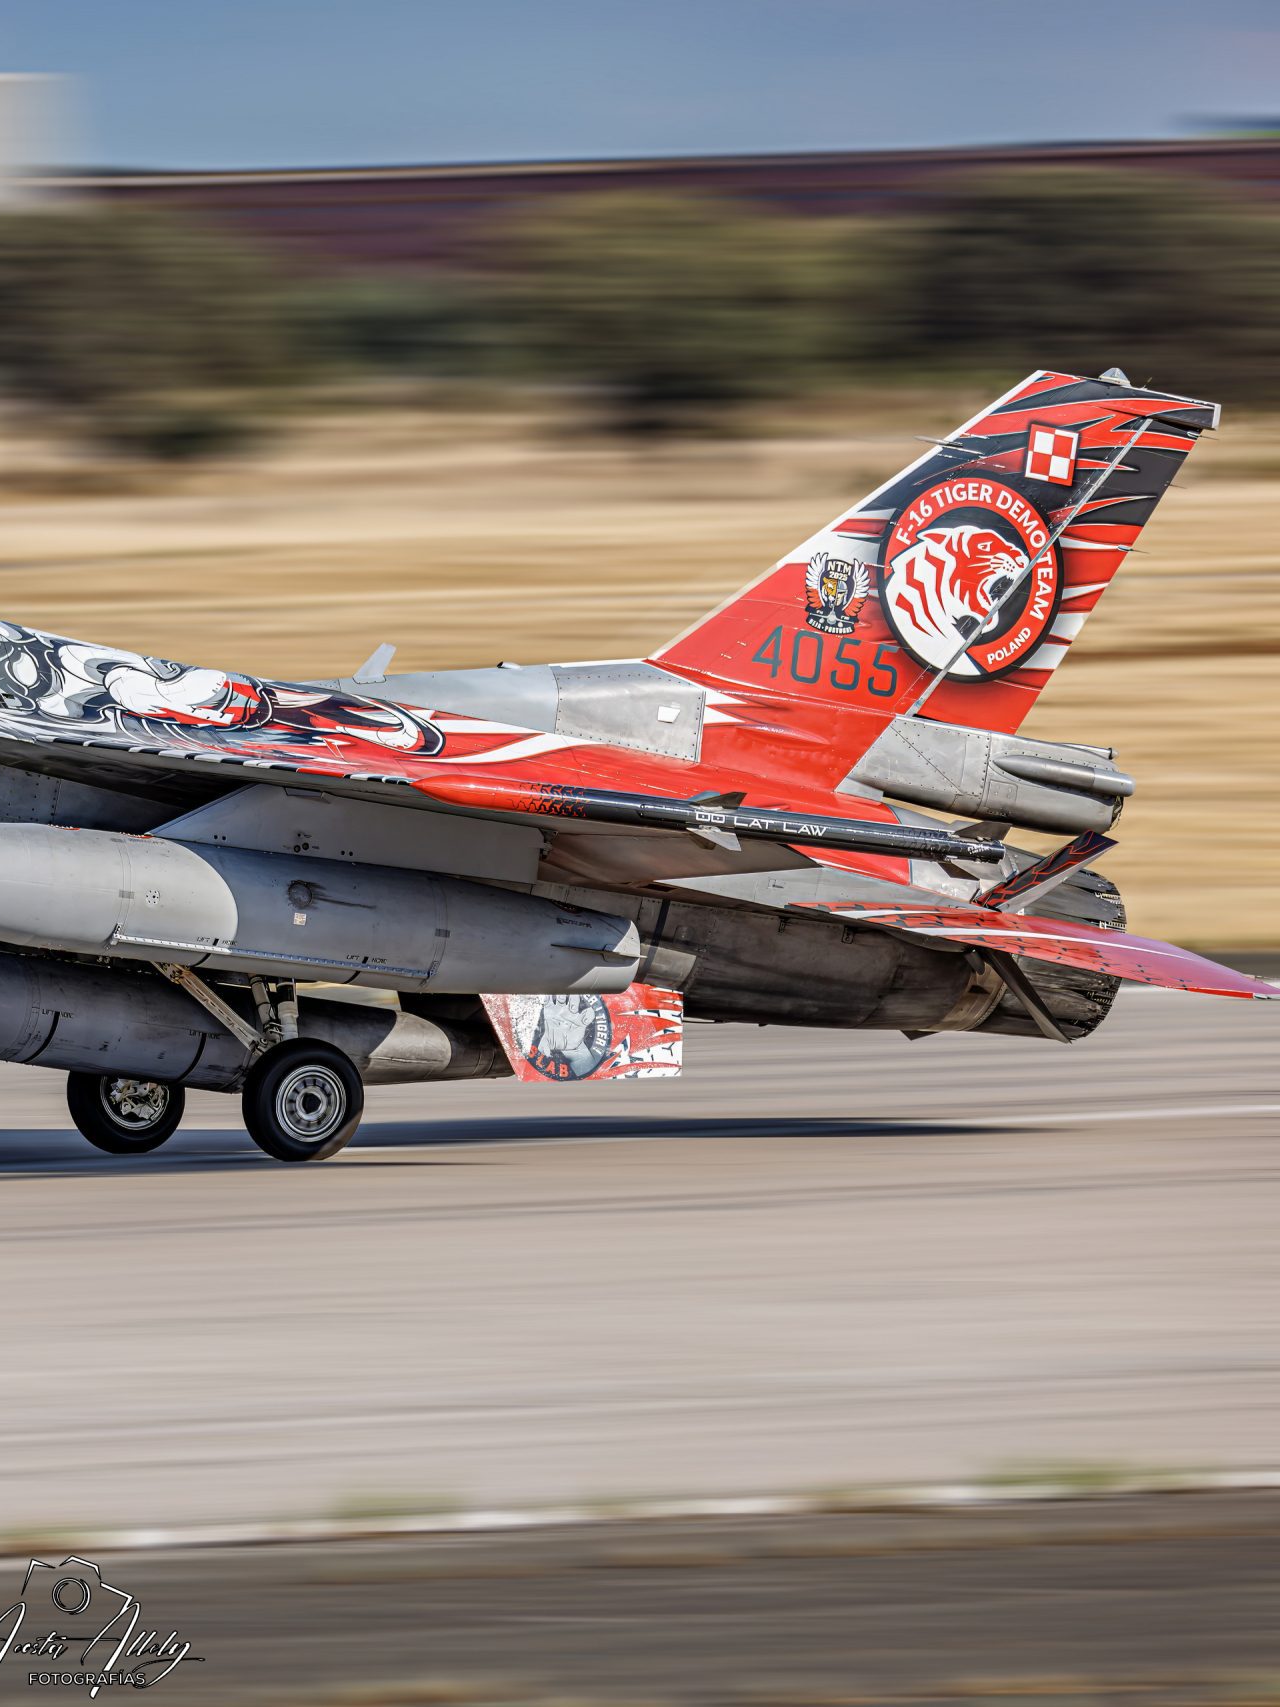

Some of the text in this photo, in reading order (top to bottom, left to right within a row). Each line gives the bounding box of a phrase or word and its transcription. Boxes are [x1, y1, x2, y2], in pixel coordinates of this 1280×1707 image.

[827, 560, 852, 577] NTM
[896, 483, 1052, 621] F-16 TIGER DEMO TEAM
[752, 625, 899, 697] 4055
[987, 627, 1032, 665] POLAND
[733, 816, 775, 829] LAT
[783, 821, 831, 837] LAW
